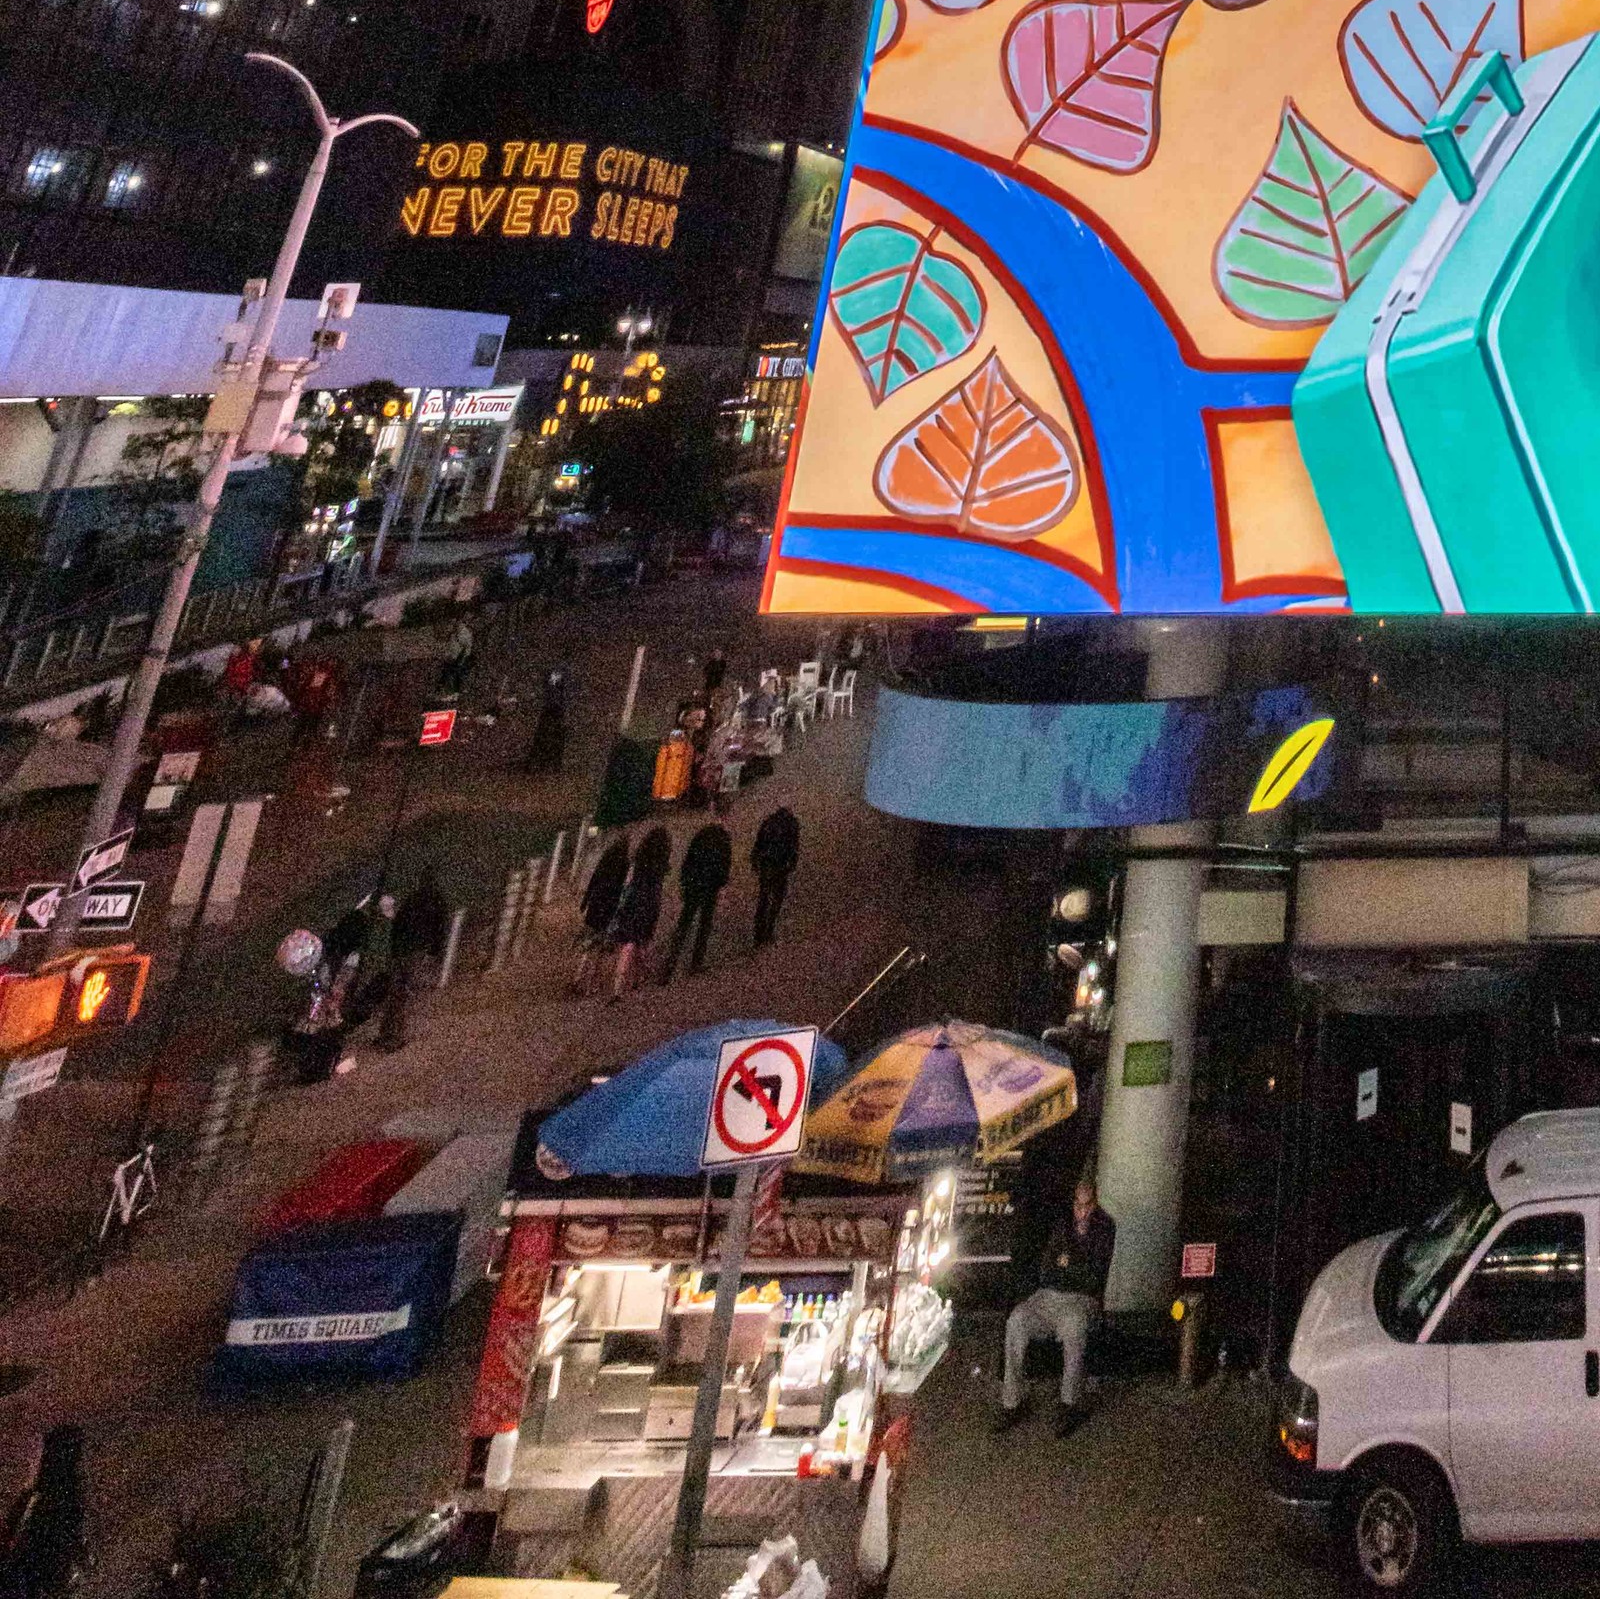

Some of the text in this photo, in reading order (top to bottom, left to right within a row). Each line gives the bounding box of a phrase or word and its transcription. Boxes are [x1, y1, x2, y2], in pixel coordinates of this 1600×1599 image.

[503, 141, 586, 179] THE
[596, 147, 646, 187] CITY
[645, 158, 689, 198] THAT
[592, 192, 678, 249] SLEEPS
[86, 897, 123, 914] WAY
[252, 1320, 310, 1341] TIMES
